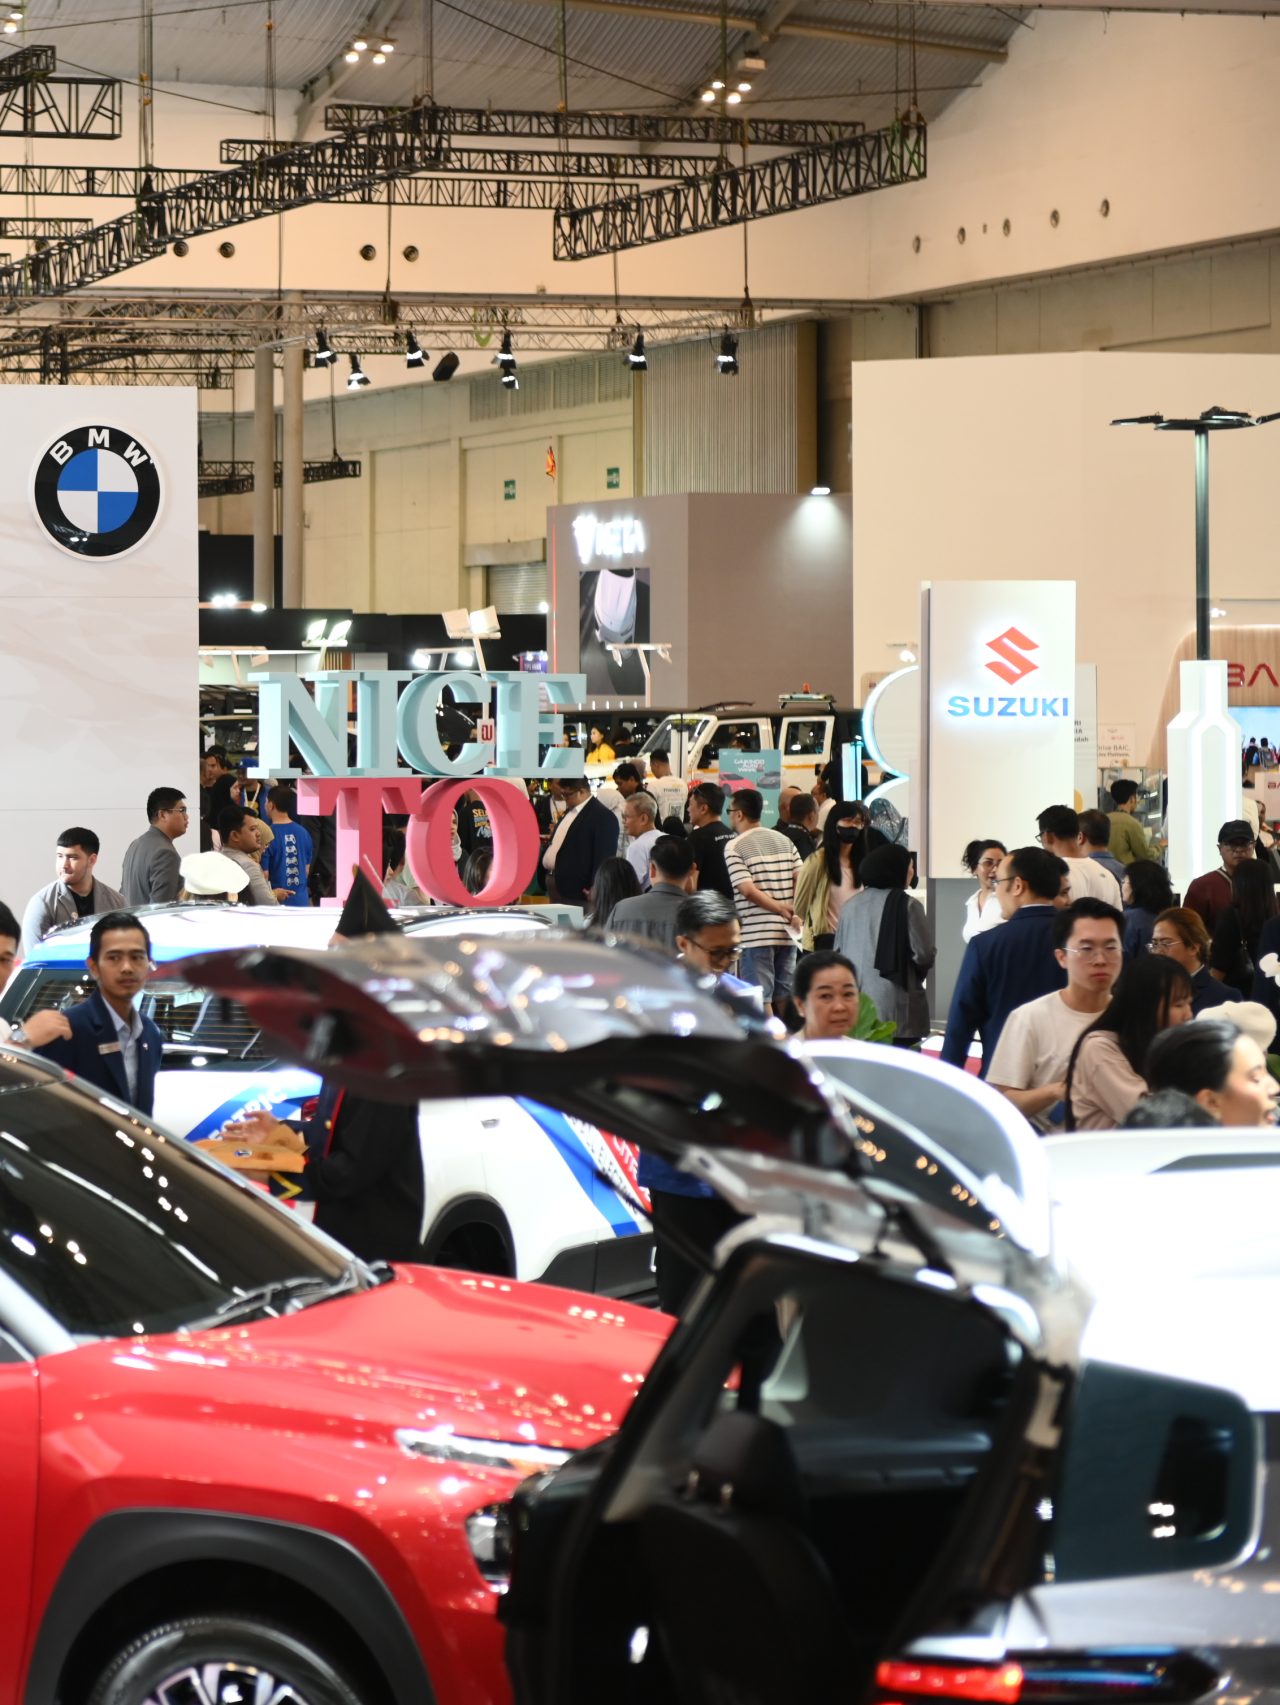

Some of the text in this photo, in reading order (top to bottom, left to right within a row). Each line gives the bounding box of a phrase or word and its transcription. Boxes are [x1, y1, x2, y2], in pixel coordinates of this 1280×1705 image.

[49, 428, 148, 467] BMW
[247, 671, 587, 779] NICE
[947, 695, 1069, 717] SUZUKI
[297, 777, 540, 908] TO
